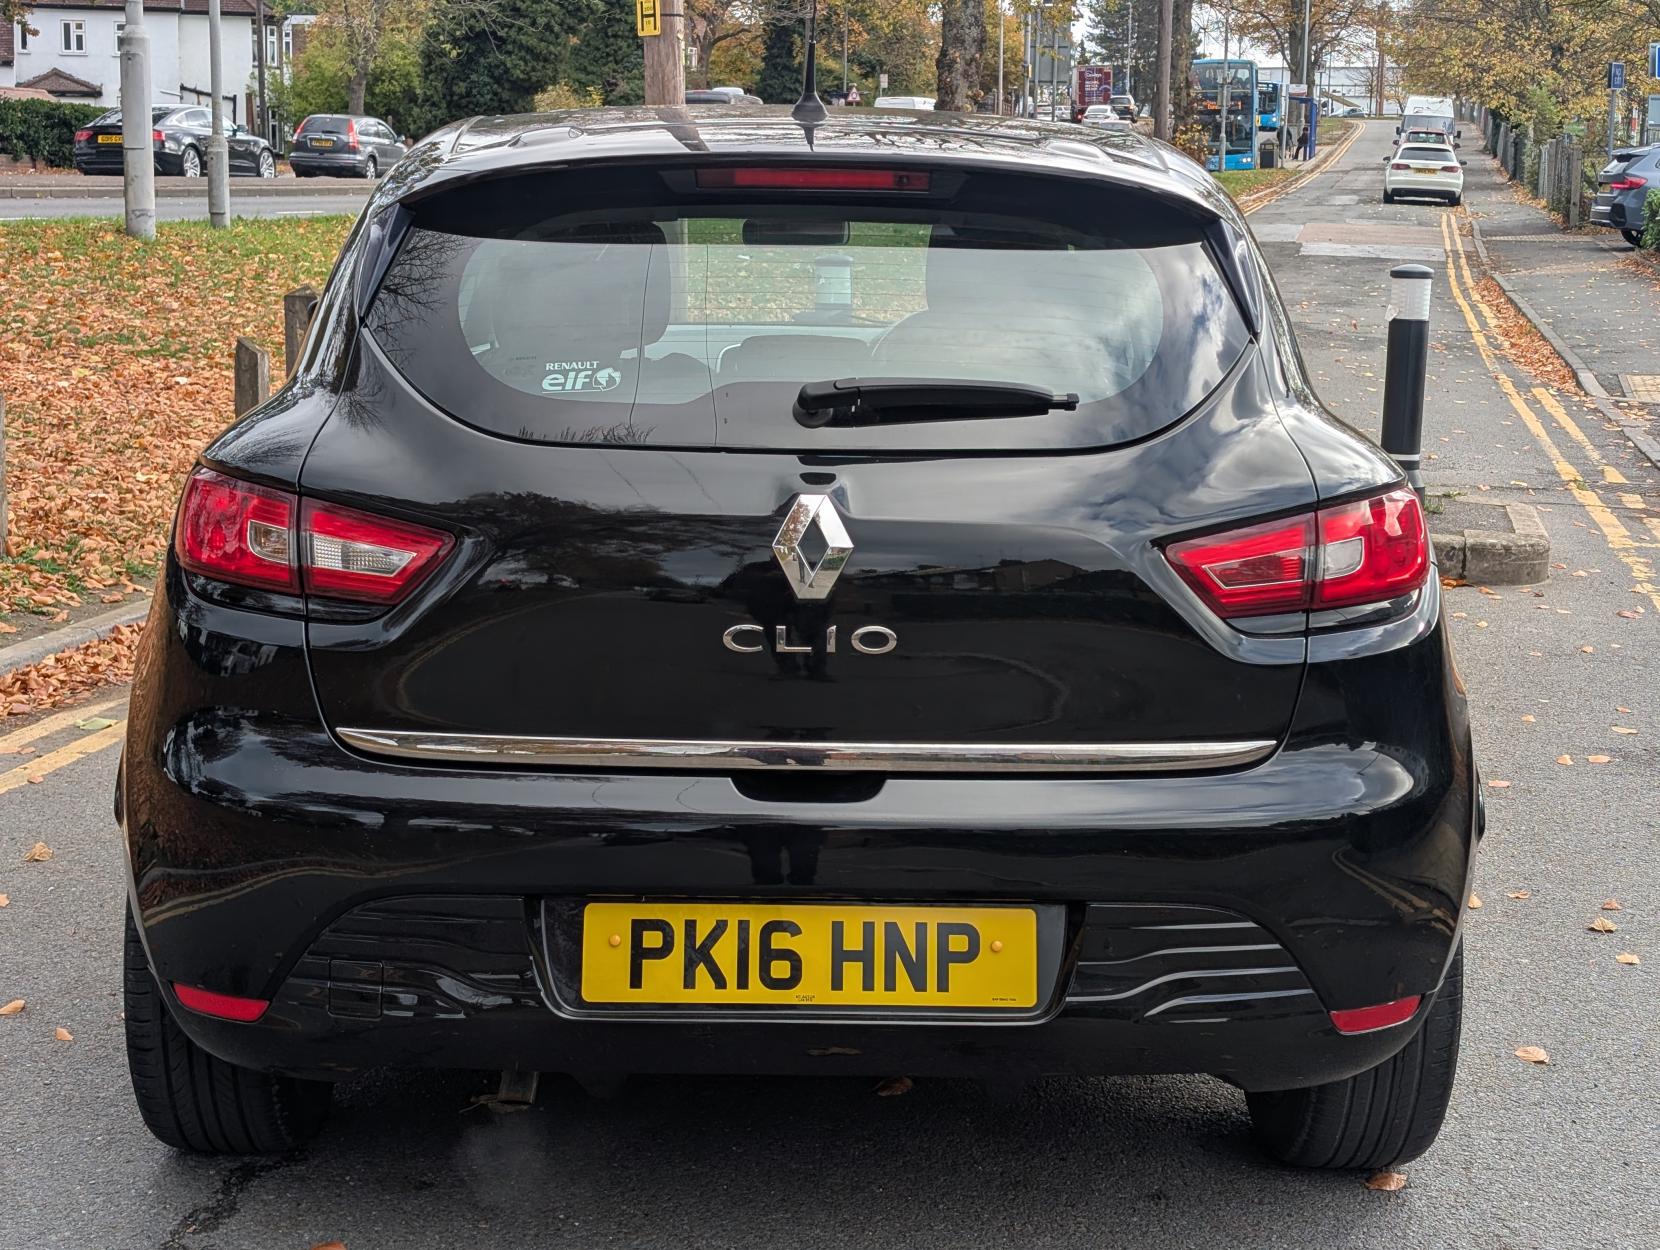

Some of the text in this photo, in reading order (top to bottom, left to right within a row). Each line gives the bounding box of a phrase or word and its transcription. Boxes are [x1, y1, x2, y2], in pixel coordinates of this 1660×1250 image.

[545, 360, 600, 371] RENAULT
[541, 370, 593, 391] elf
[722, 624, 898, 655] CLIO
[629, 917, 981, 993] PK16 HNP
